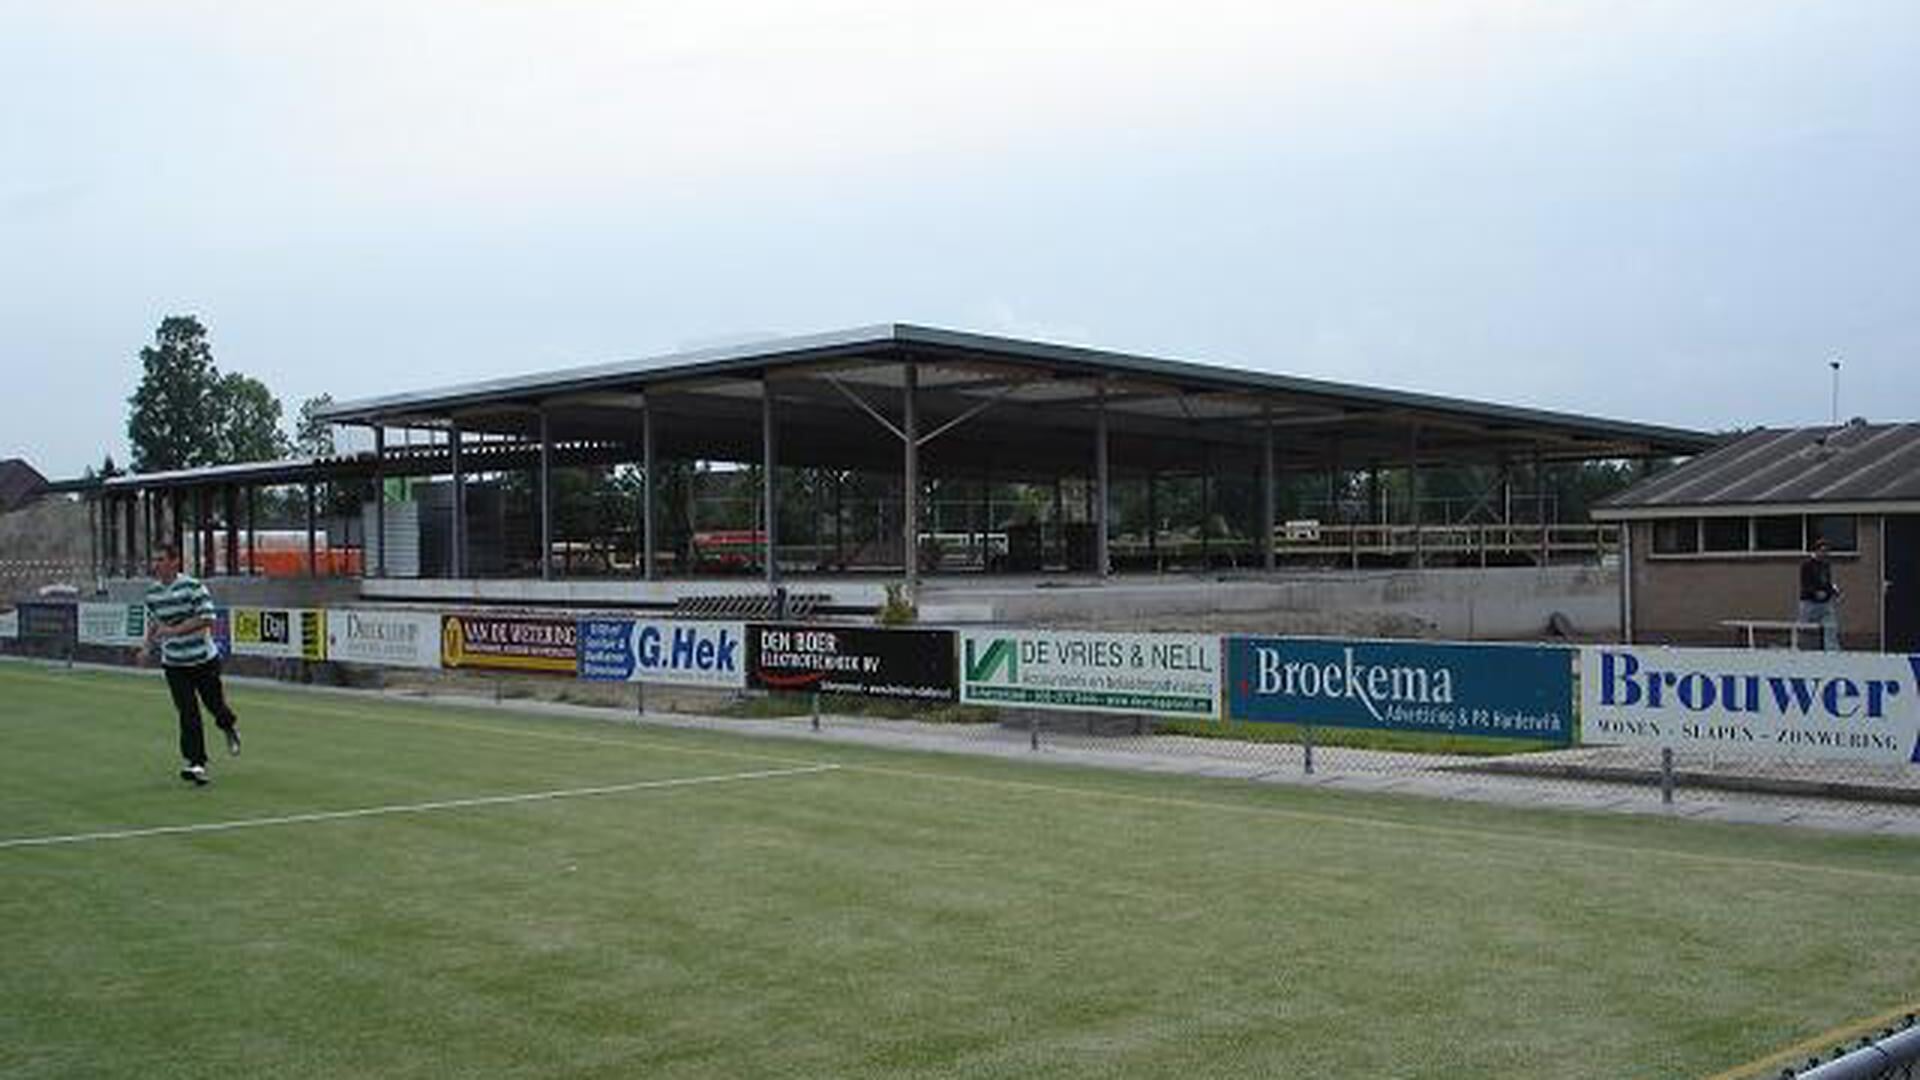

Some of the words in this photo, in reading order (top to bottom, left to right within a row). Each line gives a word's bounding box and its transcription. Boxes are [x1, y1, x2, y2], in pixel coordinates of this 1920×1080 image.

[638, 626, 738, 672] G.Hek
[761, 630, 790, 651] DEN
[793, 631, 837, 653] BOER
[1021, 640, 1050, 664] DE
[1055, 640, 1124, 668] VRIES
[1130, 644, 1144, 668] &
[1151, 643, 1213, 673] NELL
[1255, 647, 1454, 721] Broekema
[1600, 652, 1900, 718] Brouwer
[1682, 723, 1754, 741] SLAPEN
[1776, 730, 1898, 751] ZONWERING
